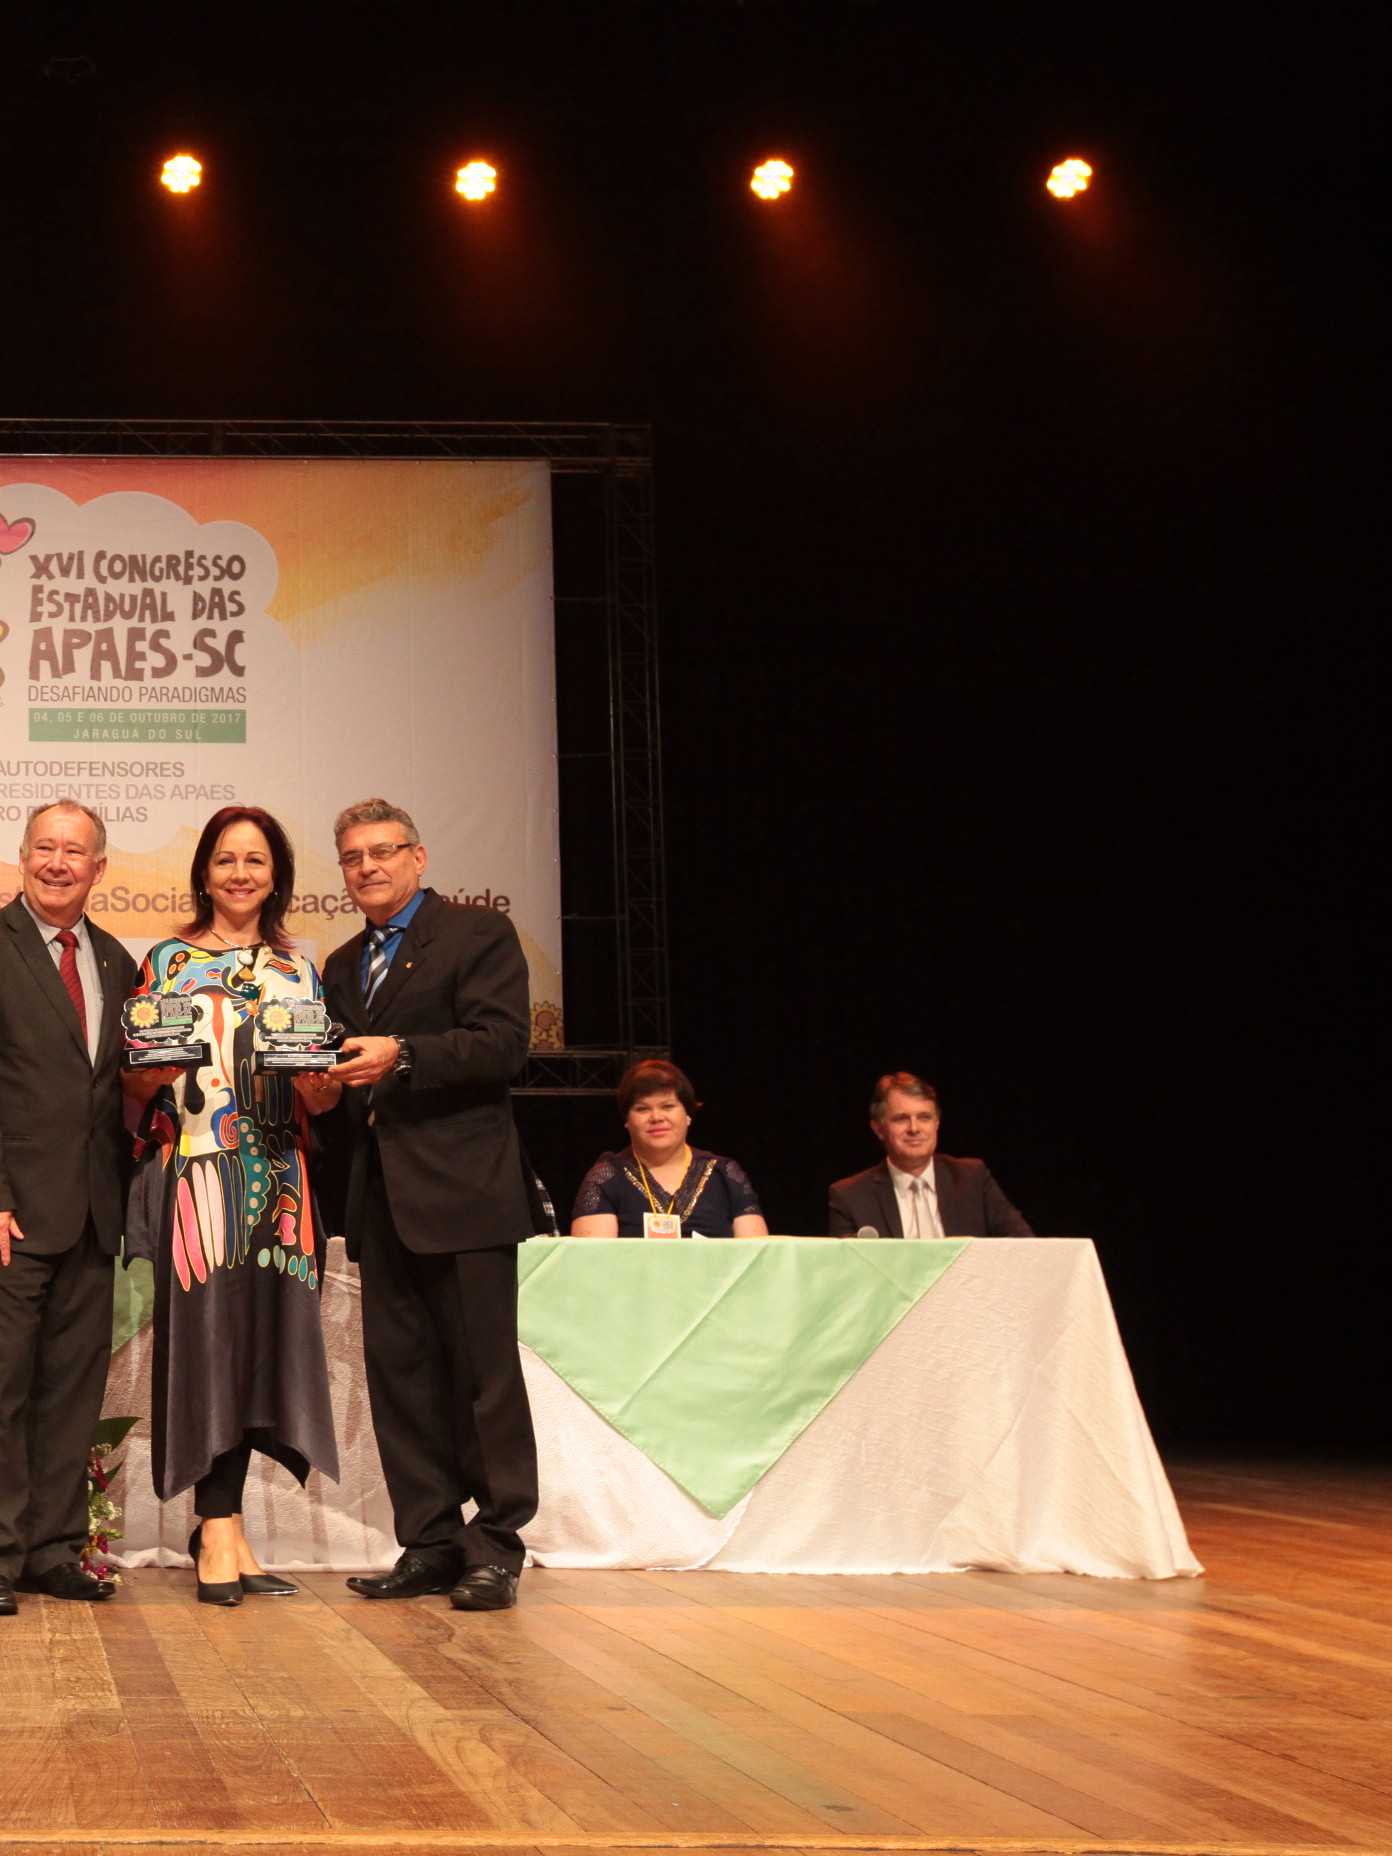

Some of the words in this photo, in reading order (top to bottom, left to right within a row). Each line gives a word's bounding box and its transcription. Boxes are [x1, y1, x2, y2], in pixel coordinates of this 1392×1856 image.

[28, 550, 85, 581] XVI
[93, 550, 246, 586] CONGRESSO
[29, 584, 176, 624] ESTADUAL
[191, 587, 246, 621] DAS
[28, 626, 247, 682] APAES-SC
[28, 685, 133, 702] DESAFIANDO
[139, 686, 247, 704] PARADIGMAS
[58, 711, 72, 723] 05
[77, 711, 84, 723] E
[89, 711, 104, 723] 06
[109, 711, 125, 723] DE
[130, 712, 186, 723] OUTUBRO
[191, 712, 207, 724] DE
[211, 713, 241, 724] 2017
[73, 727, 139, 739] JARAGUÁ
[148, 728, 166, 739] DO
[175, 729, 202, 740] SUL
[125, 783, 166, 800] DAS
[170, 784, 236, 801] APAES
